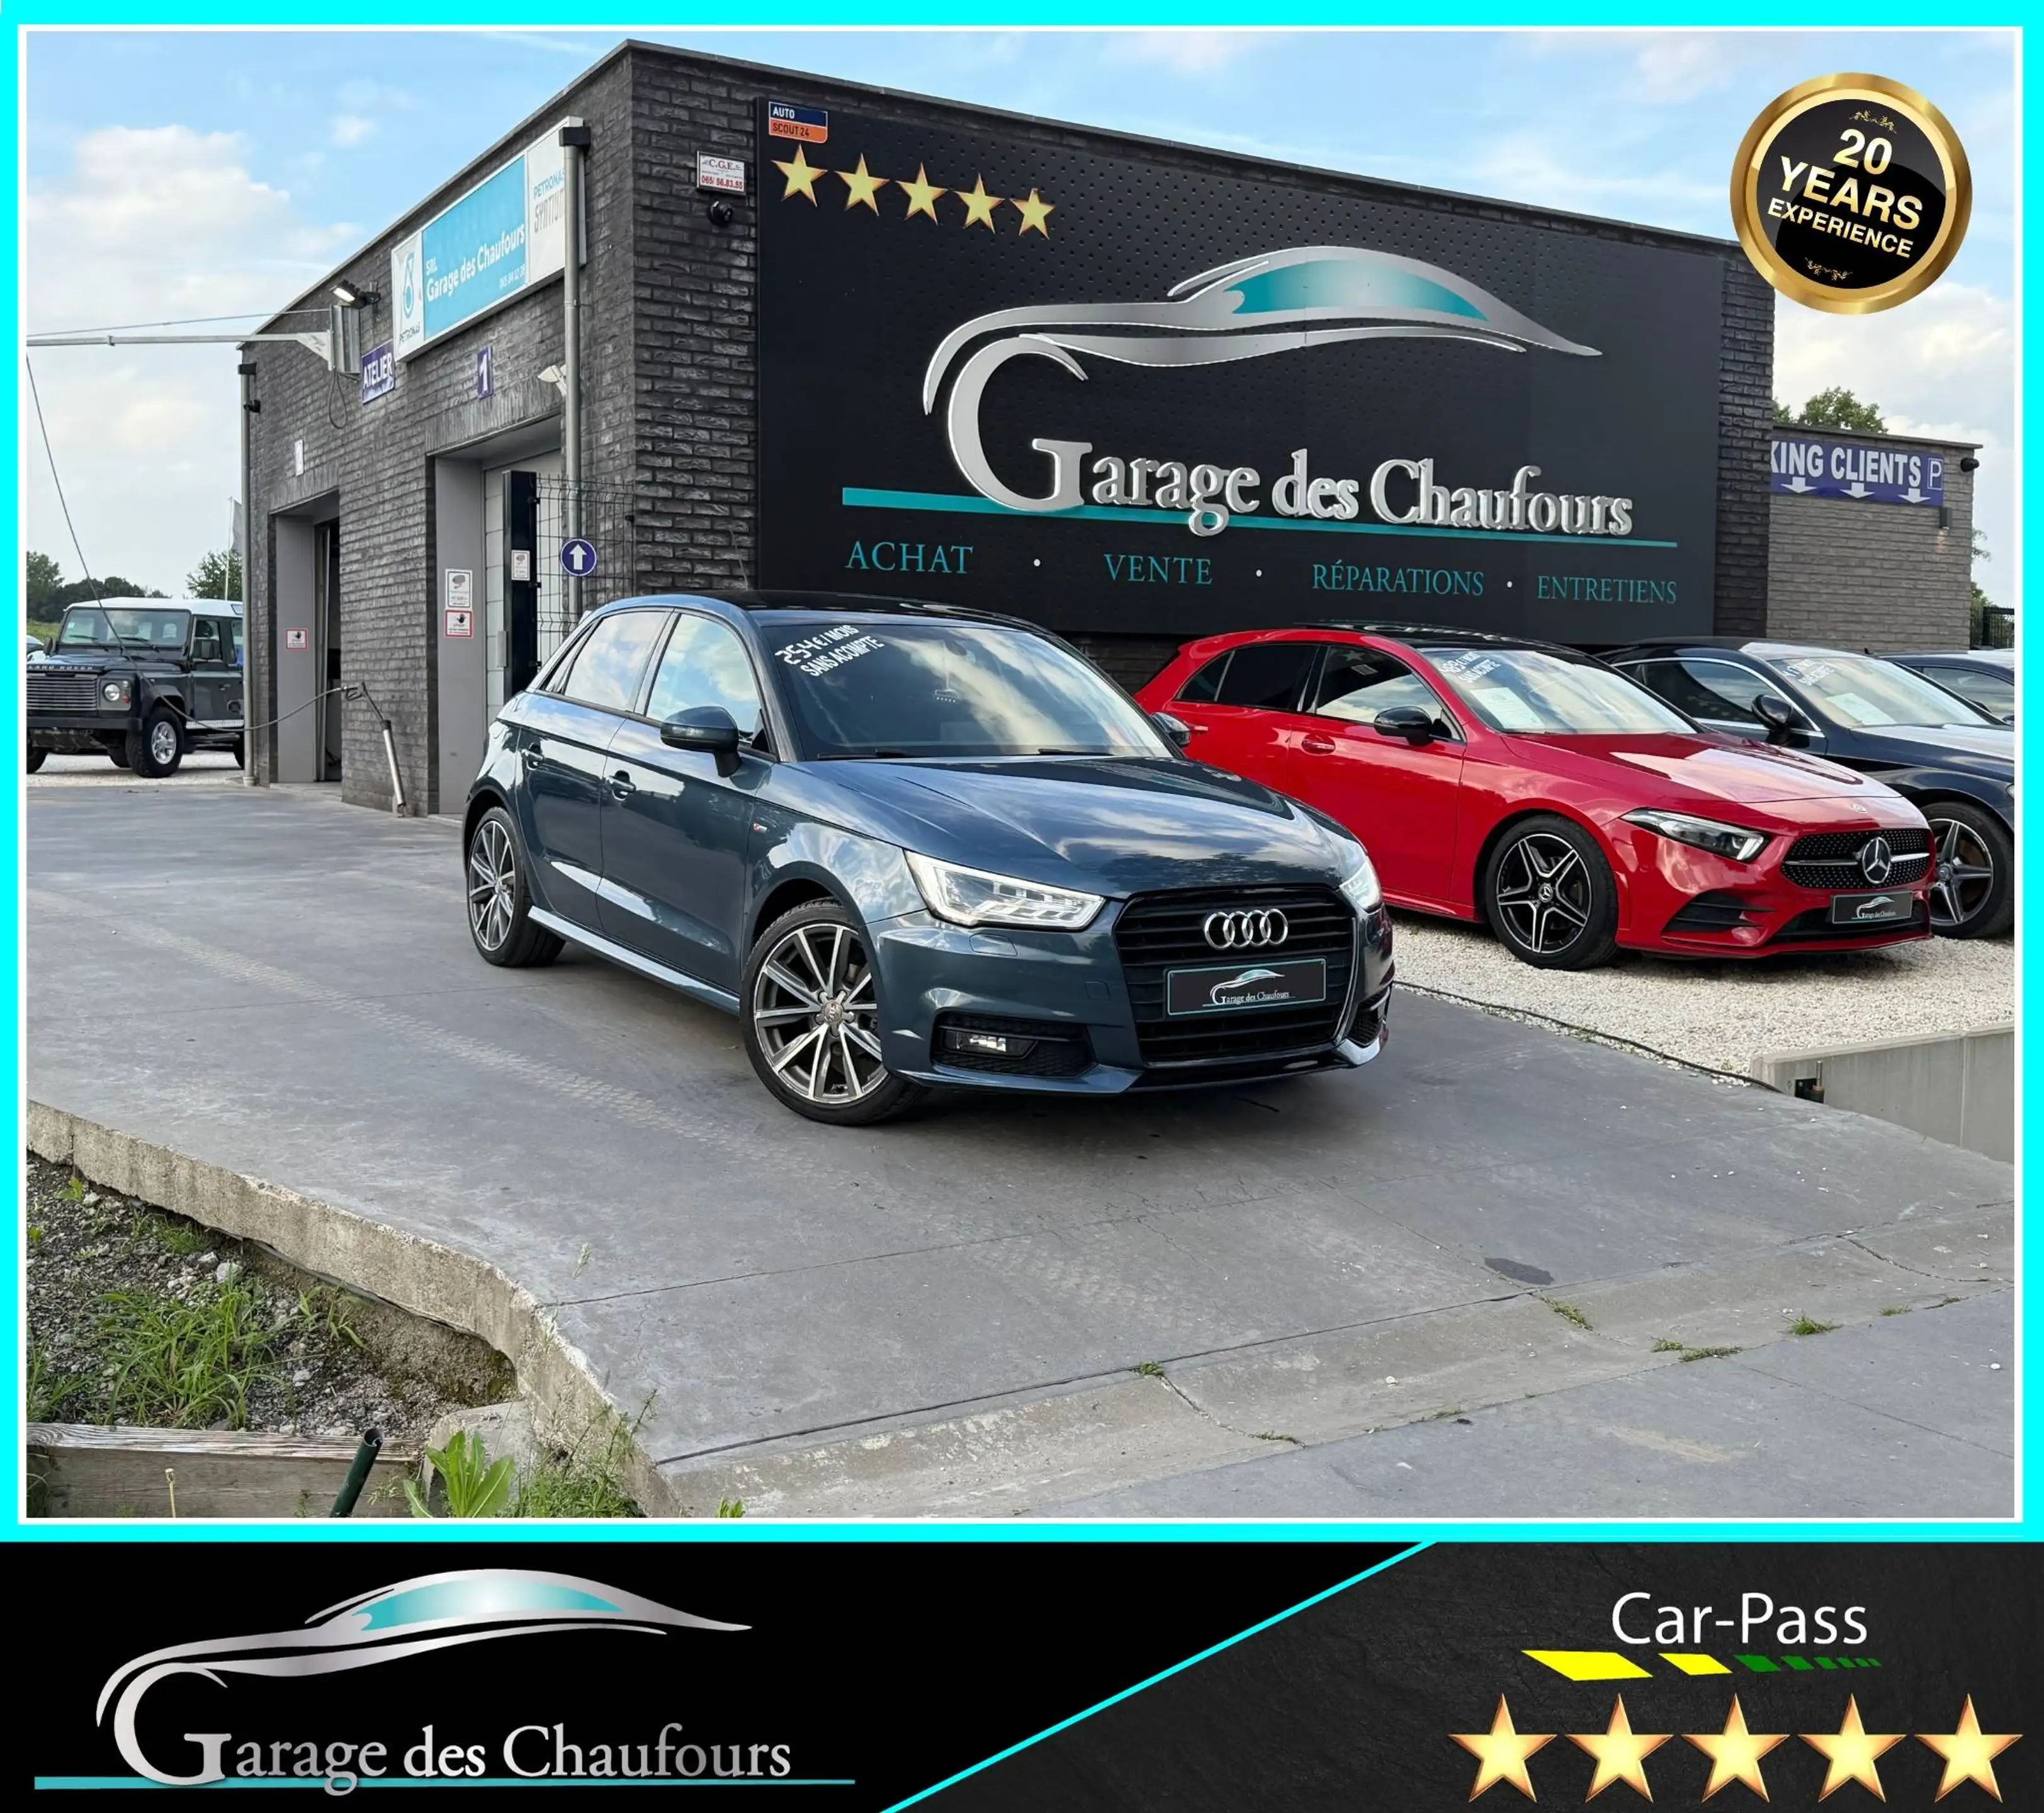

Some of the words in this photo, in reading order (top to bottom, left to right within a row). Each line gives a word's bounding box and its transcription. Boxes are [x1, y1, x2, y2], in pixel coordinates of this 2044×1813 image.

[772, 106, 795, 119] AUTO
[772, 123, 799, 135] SCOUT
[800, 127, 810, 137] 24
[426, 268, 459, 302] Garage
[460, 257, 476, 283] des
[477, 223, 525, 272] Chaufours
[426, 256, 438, 276] SRL
[363, 352, 393, 390] ATELIER
[479, 354, 488, 392] 1
[948, 336, 1260, 537] Garage
[1272, 448, 1360, 520] des
[1370, 458, 1633, 534] Chaufours
[1831, 447, 1922, 488] CLIENTS
[1929, 460, 1943, 488] P
[845, 539, 974, 574] ACHAT
[1103, 553, 1213, 585] VENTE
[1312, 559, 1484, 597] RÉPARATIONS
[1537, 575, 1677, 604] ENTRETIENS
[800, 655, 839, 677] SANS
[828, 635, 885, 664] ACOMPTE
[1211, 986, 1245, 1005] Garage
[1246, 993, 1256, 1001] des
